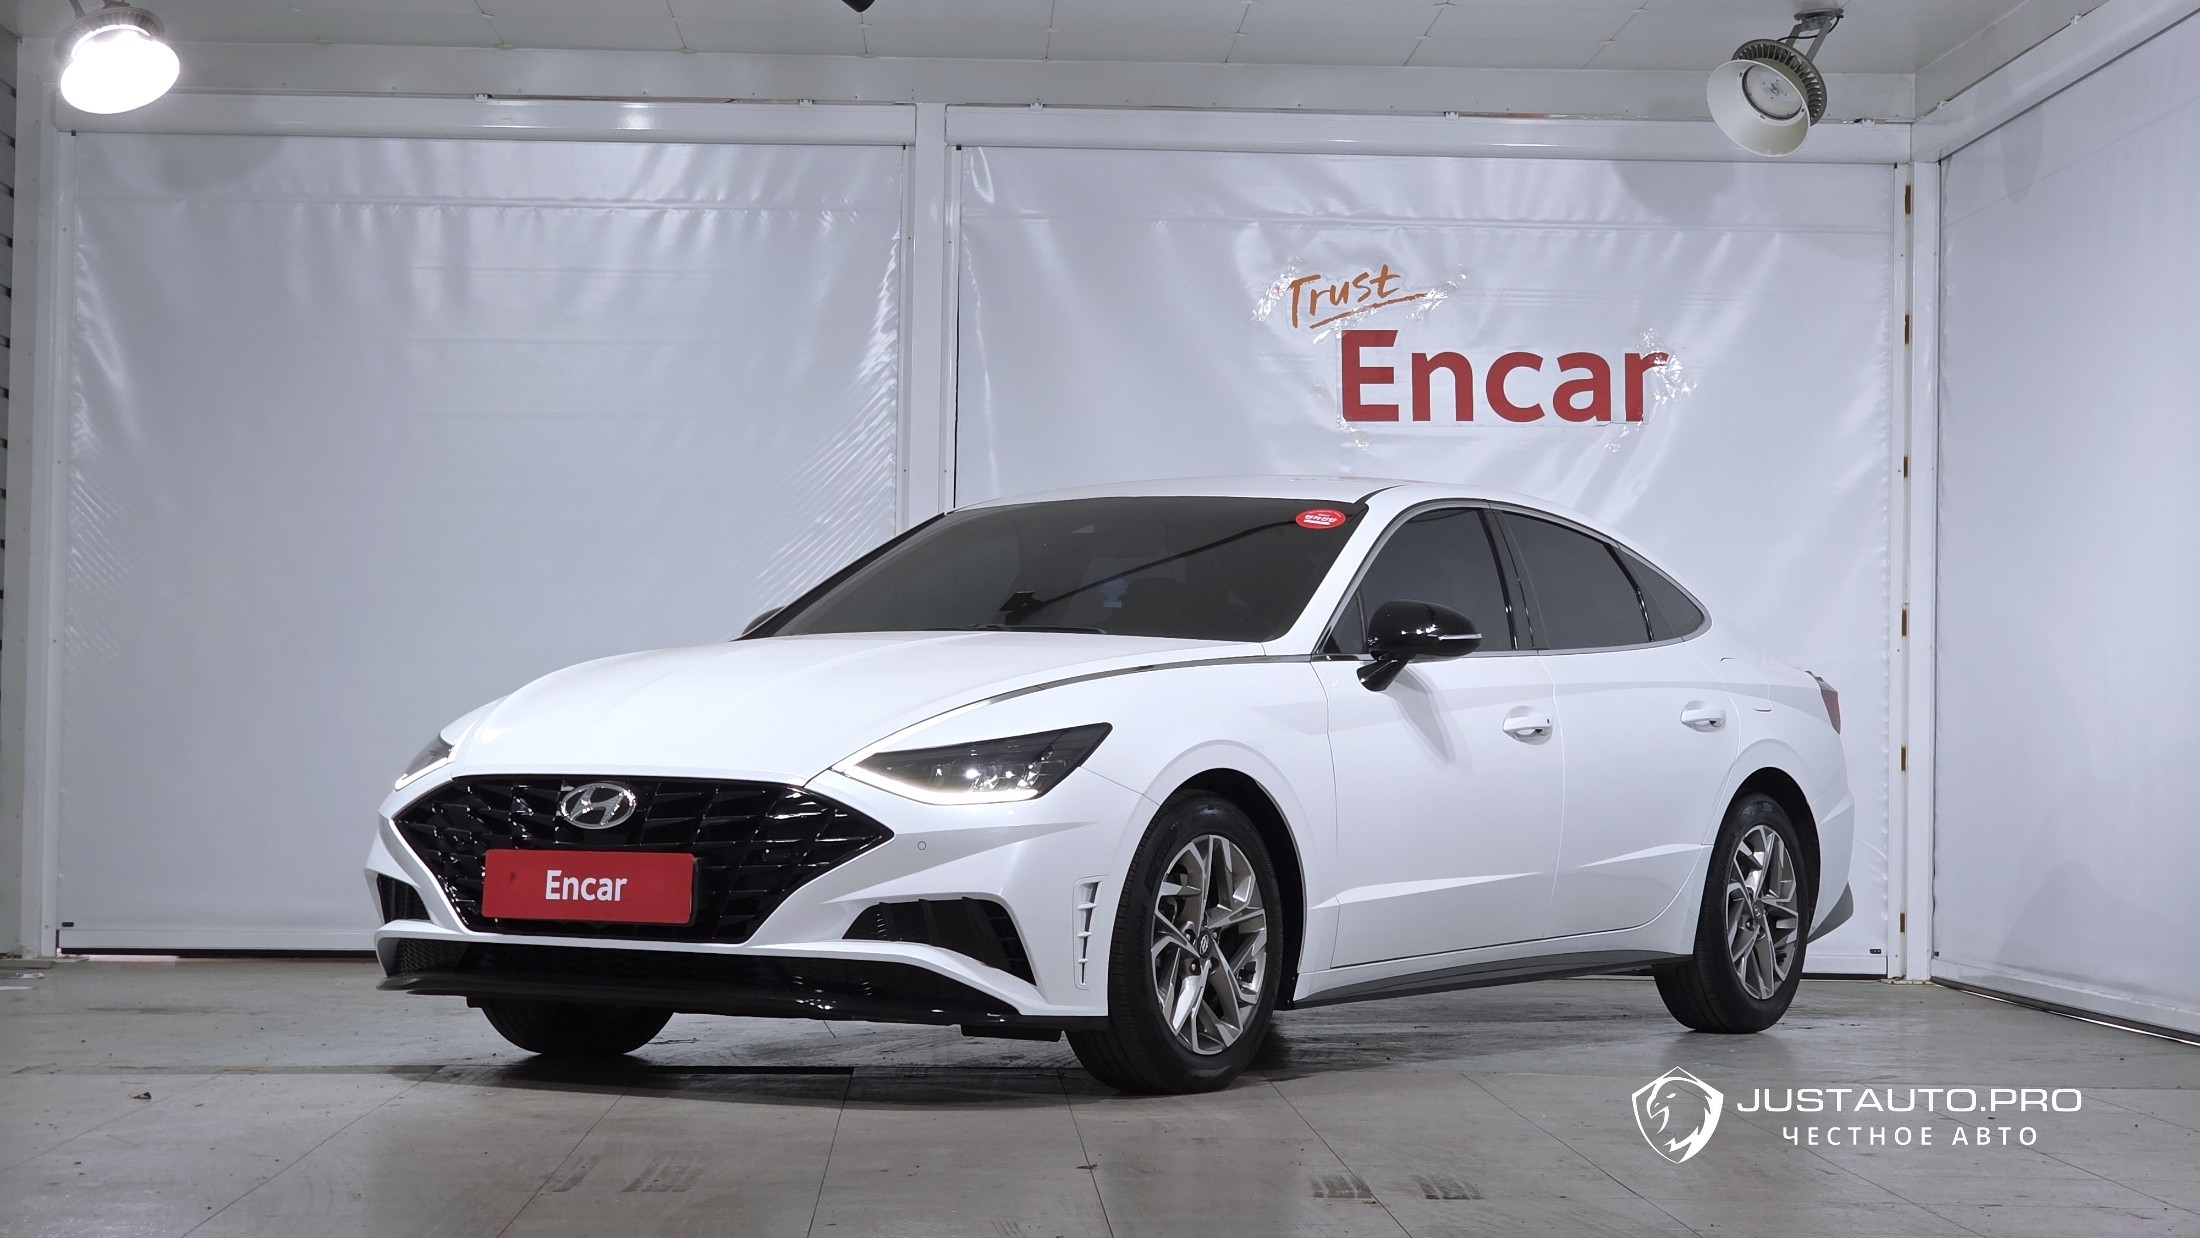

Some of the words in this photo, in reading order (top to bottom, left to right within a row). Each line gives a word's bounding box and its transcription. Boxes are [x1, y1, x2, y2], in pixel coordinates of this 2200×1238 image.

[1289, 264, 1401, 329] Trust
[1341, 329, 1669, 423] Encar
[545, 869, 627, 902] Encar
